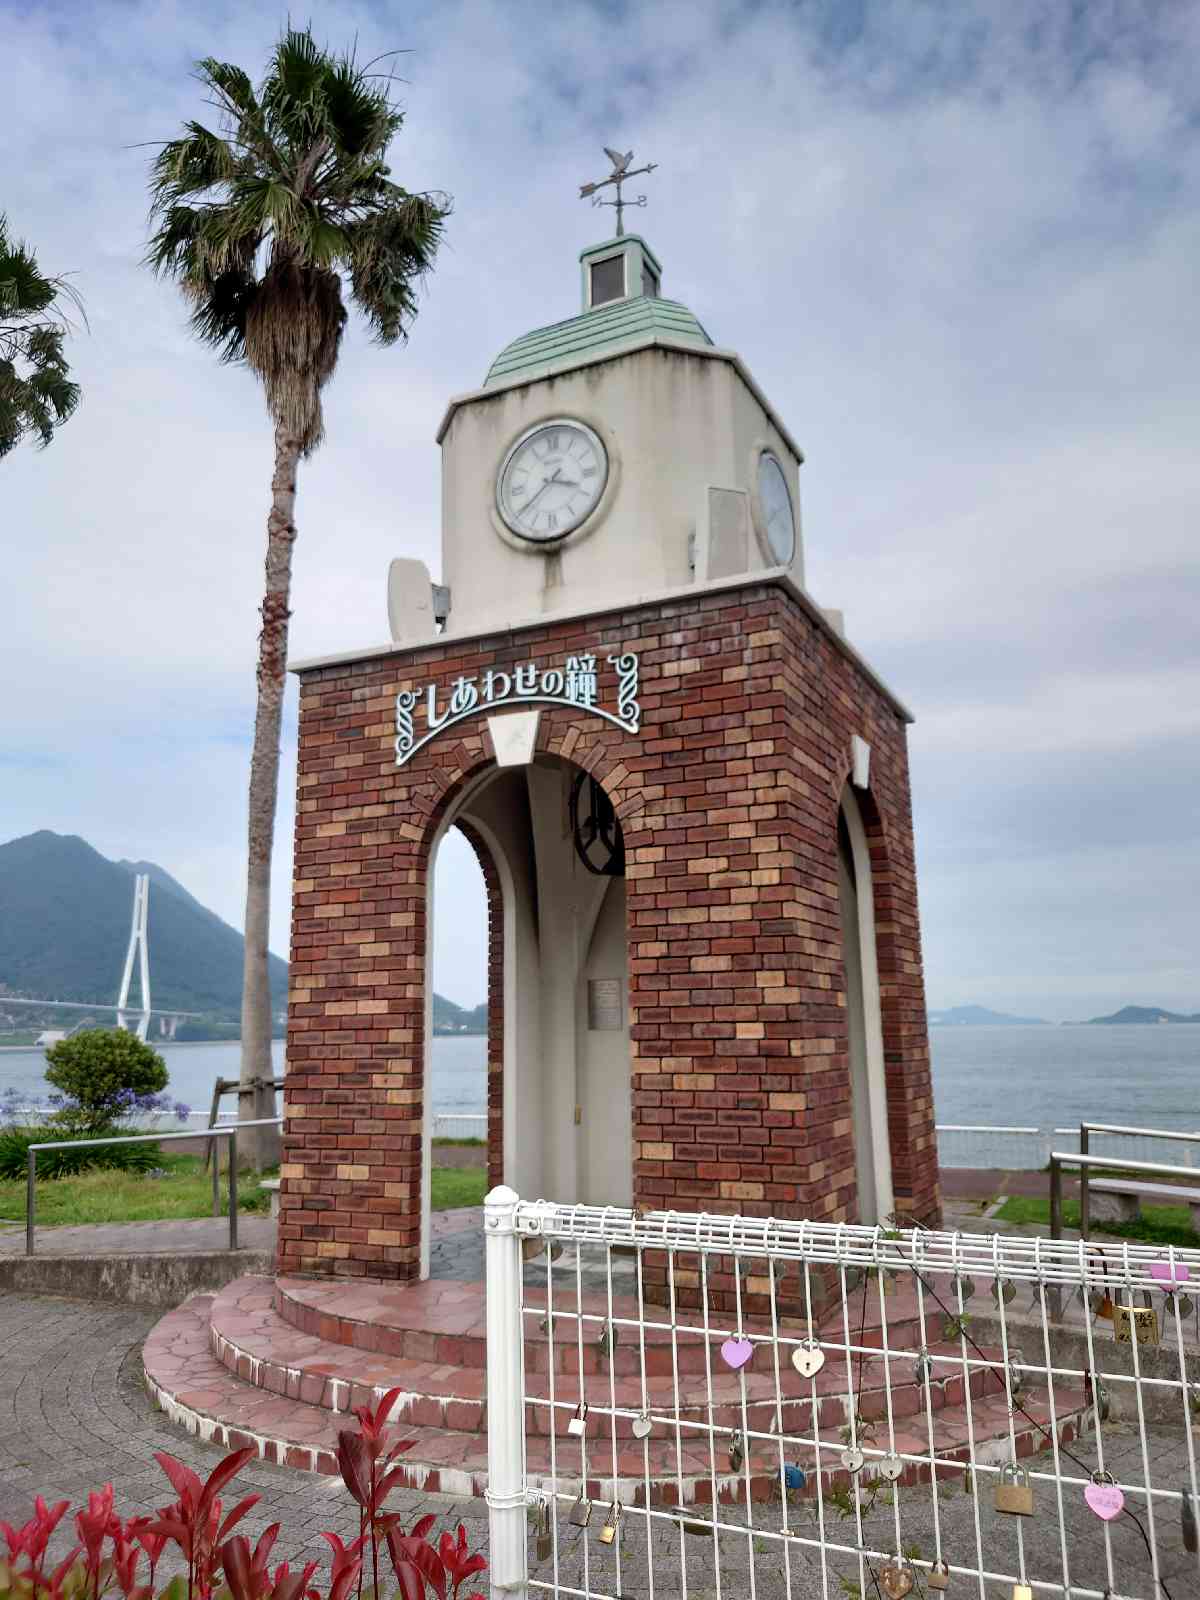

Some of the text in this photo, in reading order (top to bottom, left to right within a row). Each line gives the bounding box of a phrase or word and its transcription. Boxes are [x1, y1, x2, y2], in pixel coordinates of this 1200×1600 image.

[427, 654, 598, 729] しあわせの鐘
